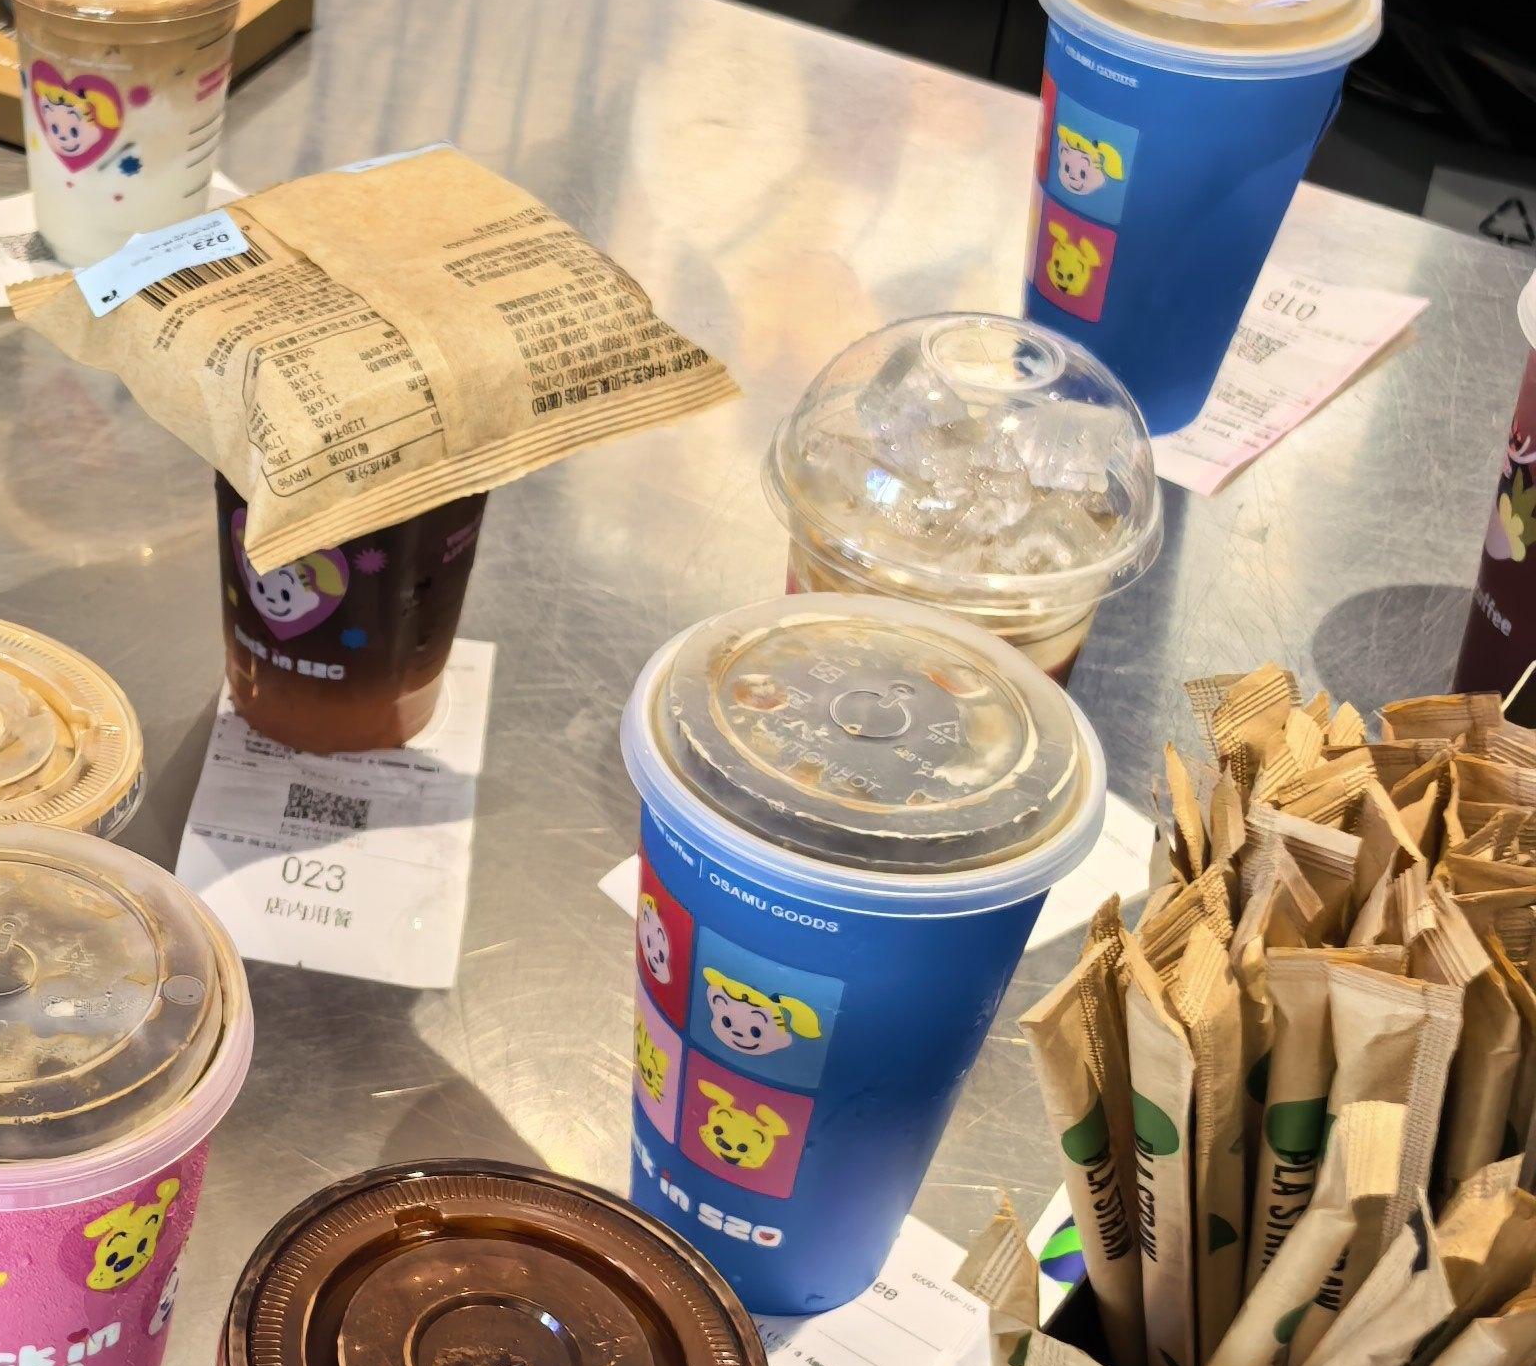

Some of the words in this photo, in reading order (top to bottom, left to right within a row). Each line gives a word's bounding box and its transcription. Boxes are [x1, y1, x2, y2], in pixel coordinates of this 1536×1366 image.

[193, 233, 229, 251] 023
[266, 448, 291, 468] 13%
[280, 855, 348, 893] 023
[708, 872, 767, 912] OSAMU
[770, 904, 841, 934] GOODS
[1269, 1148, 1312, 1198] PLA
[659, 1168, 690, 1212] in
[697, 1201, 785, 1248] 520
[66, 1319, 122, 1366] in
